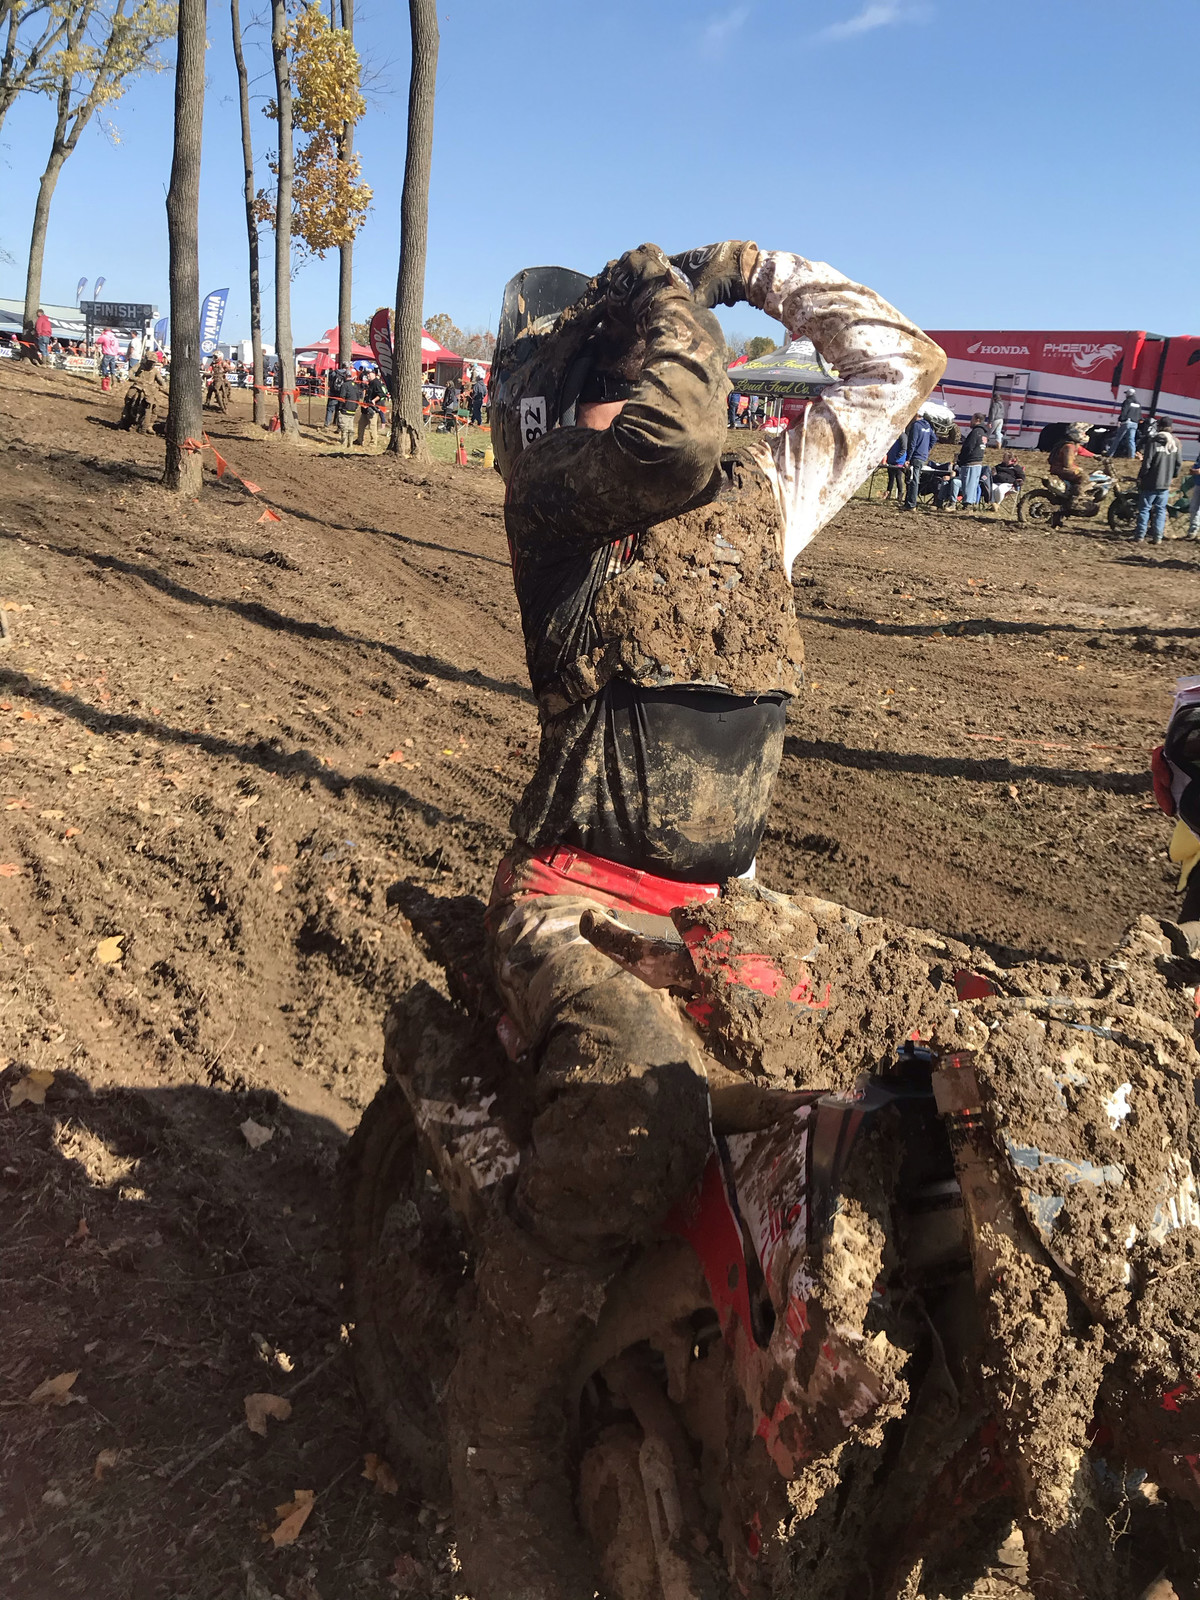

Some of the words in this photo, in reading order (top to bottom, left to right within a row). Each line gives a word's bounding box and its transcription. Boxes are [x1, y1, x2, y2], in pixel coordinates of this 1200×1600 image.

[93, 303, 137, 319] FINISH
[204, 296, 221, 340] YAMAHA
[374, 327, 393, 377] 100%
[980, 345, 1030, 355] HONDA
[1043, 343, 1100, 353] PHOENIX
[734, 378, 764, 392] Loud
[764, 381, 795, 394] Fuel
[794, 382, 810, 395] Co.
[525, 407, 543, 443] 82
